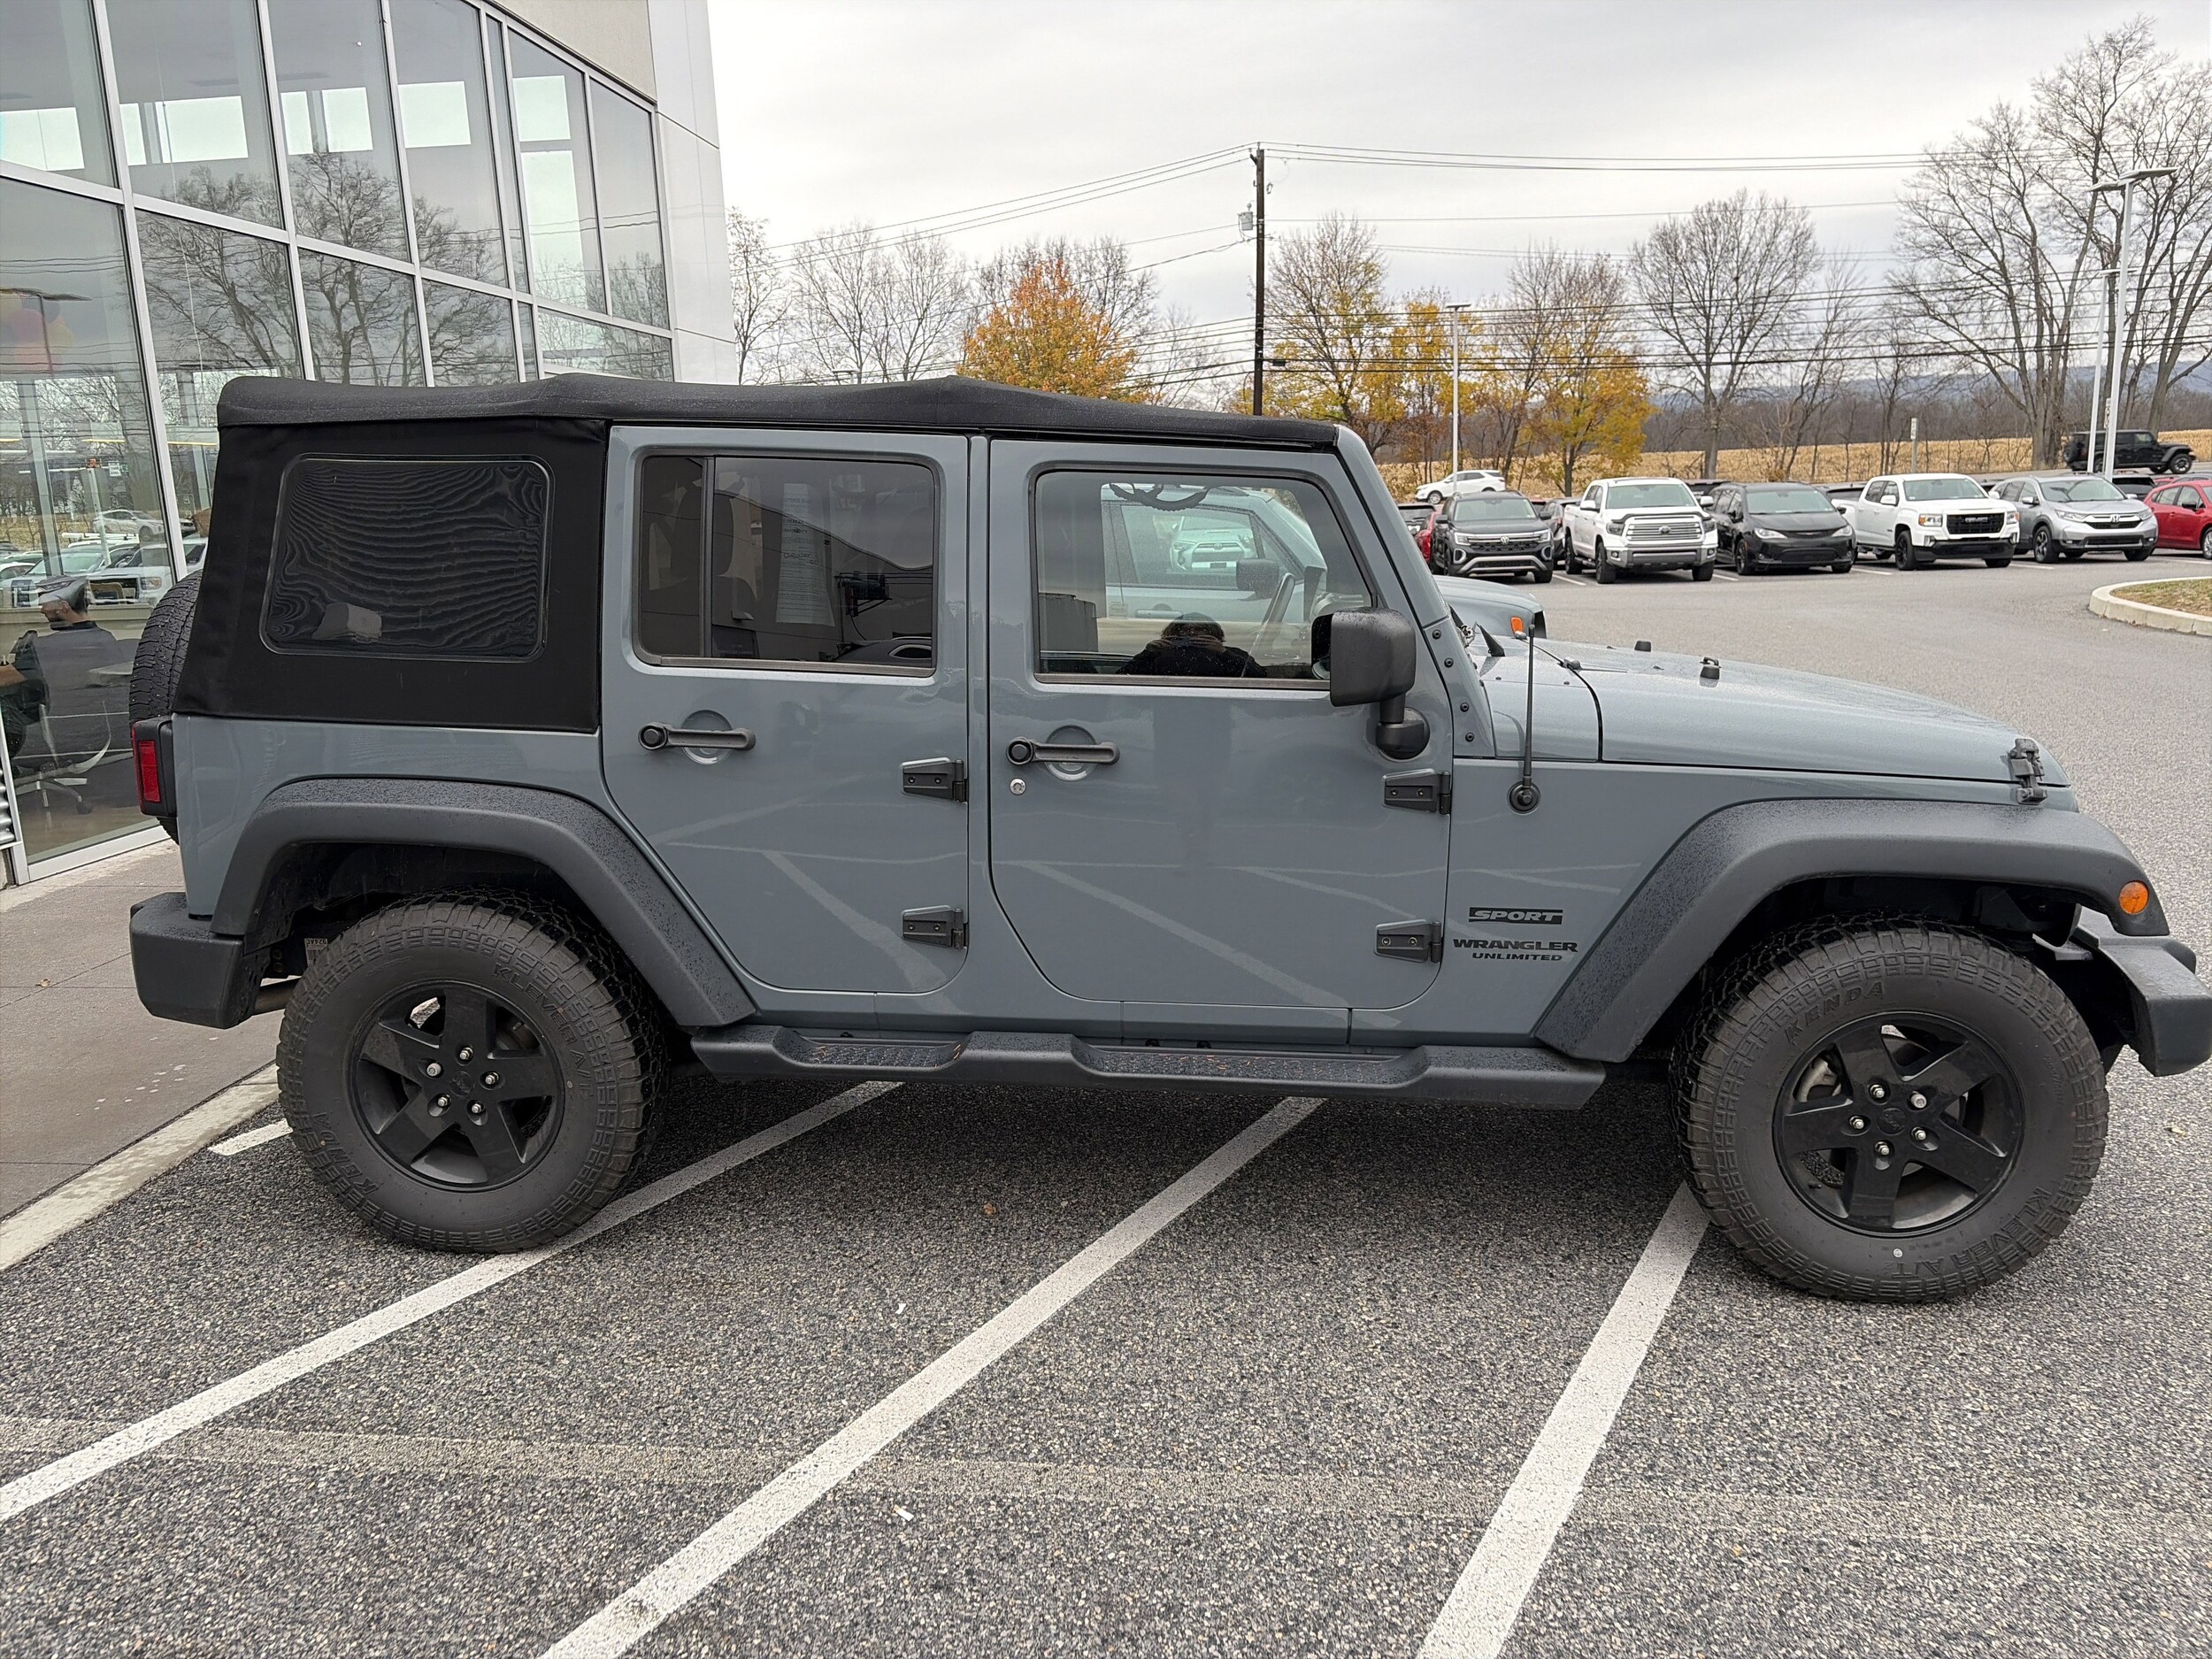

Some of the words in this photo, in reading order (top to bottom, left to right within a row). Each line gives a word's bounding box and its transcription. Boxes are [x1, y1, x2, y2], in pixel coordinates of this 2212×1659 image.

[1453, 939, 1578, 953] WRANGLER
[1473, 908, 1563, 922] SPORT
[1472, 952, 1563, 962] UNLIMITED
[492, 962, 578, 1046] KLEVER
[1784, 981, 1884, 1048] KENDA
[311, 1111, 379, 1194] KENDA
[1949, 1186, 2052, 1269] KLEVER
